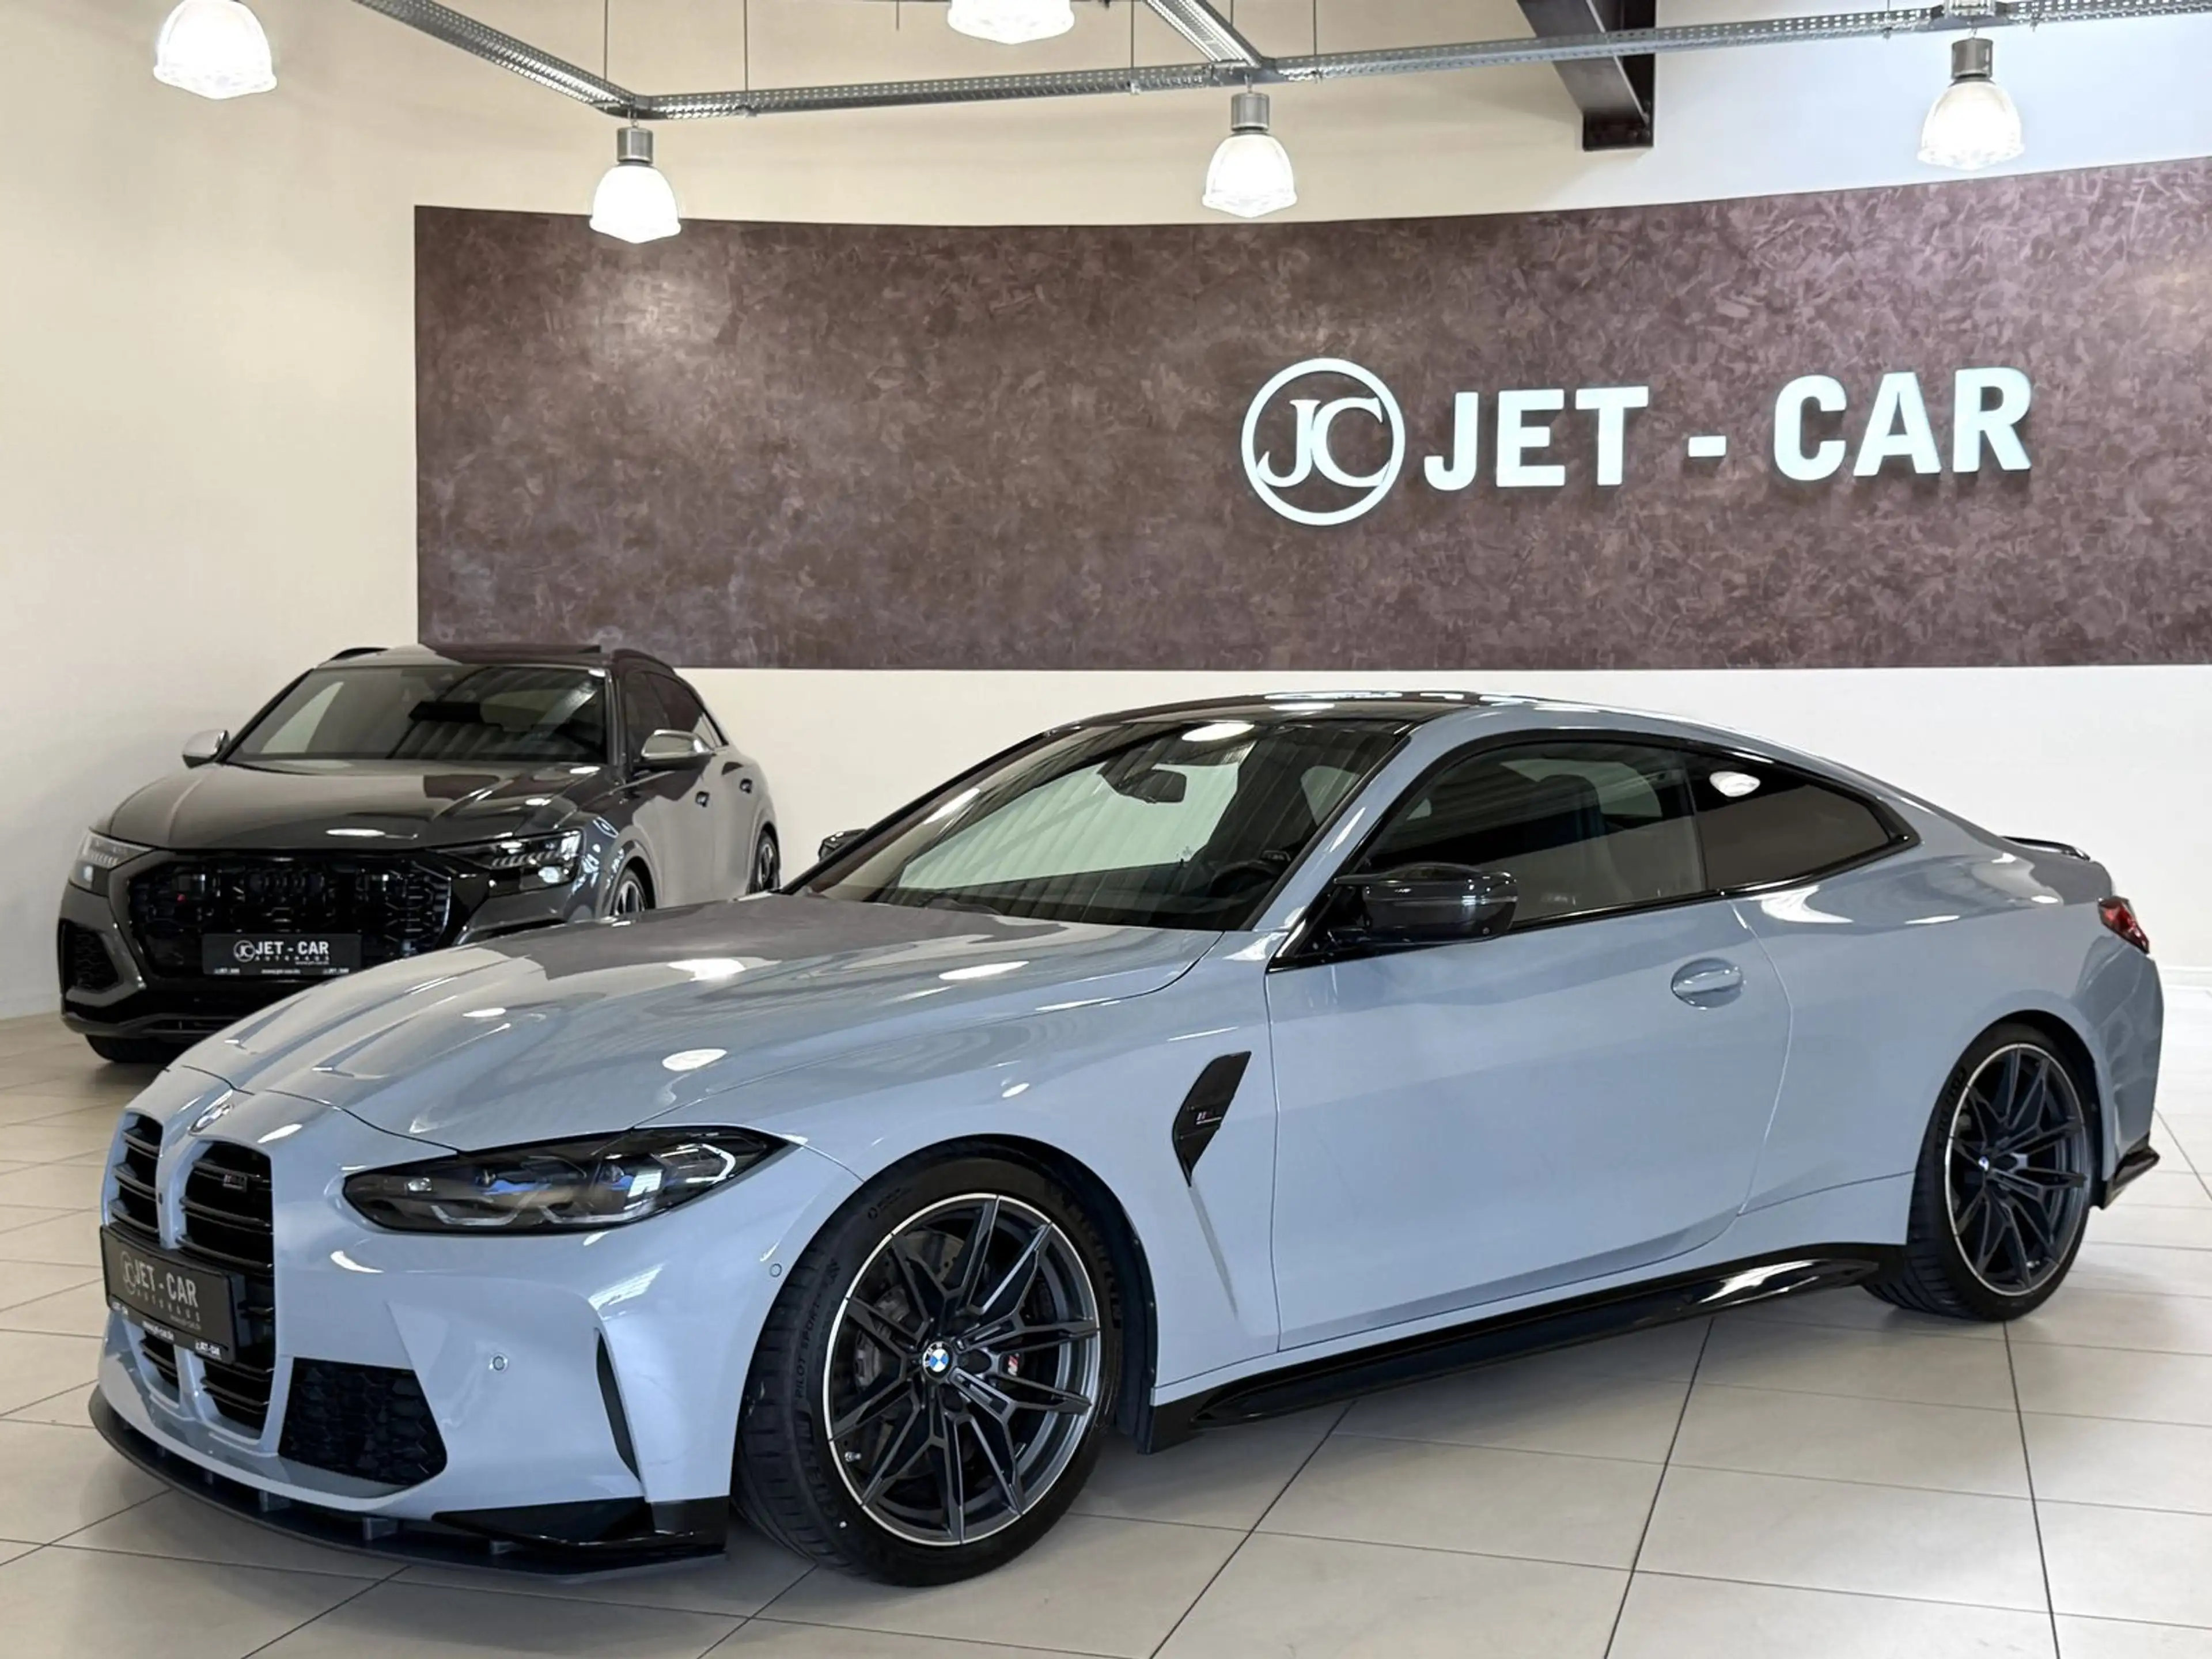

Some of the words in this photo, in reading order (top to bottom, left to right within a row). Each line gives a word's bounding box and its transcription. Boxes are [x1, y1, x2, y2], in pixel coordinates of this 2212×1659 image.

[1255, 397, 1384, 487] JC
[1424, 385, 1649, 491] JET
[1688, 435, 1727, 457] -
[1774, 367, 2032, 481] CAR
[255, 941, 285, 955] JET
[297, 941, 330, 956] CAR
[135, 1259, 155, 1292] JET
[166, 1271, 199, 1308] CAR
[794, 1354, 806, 1399] PILOT
